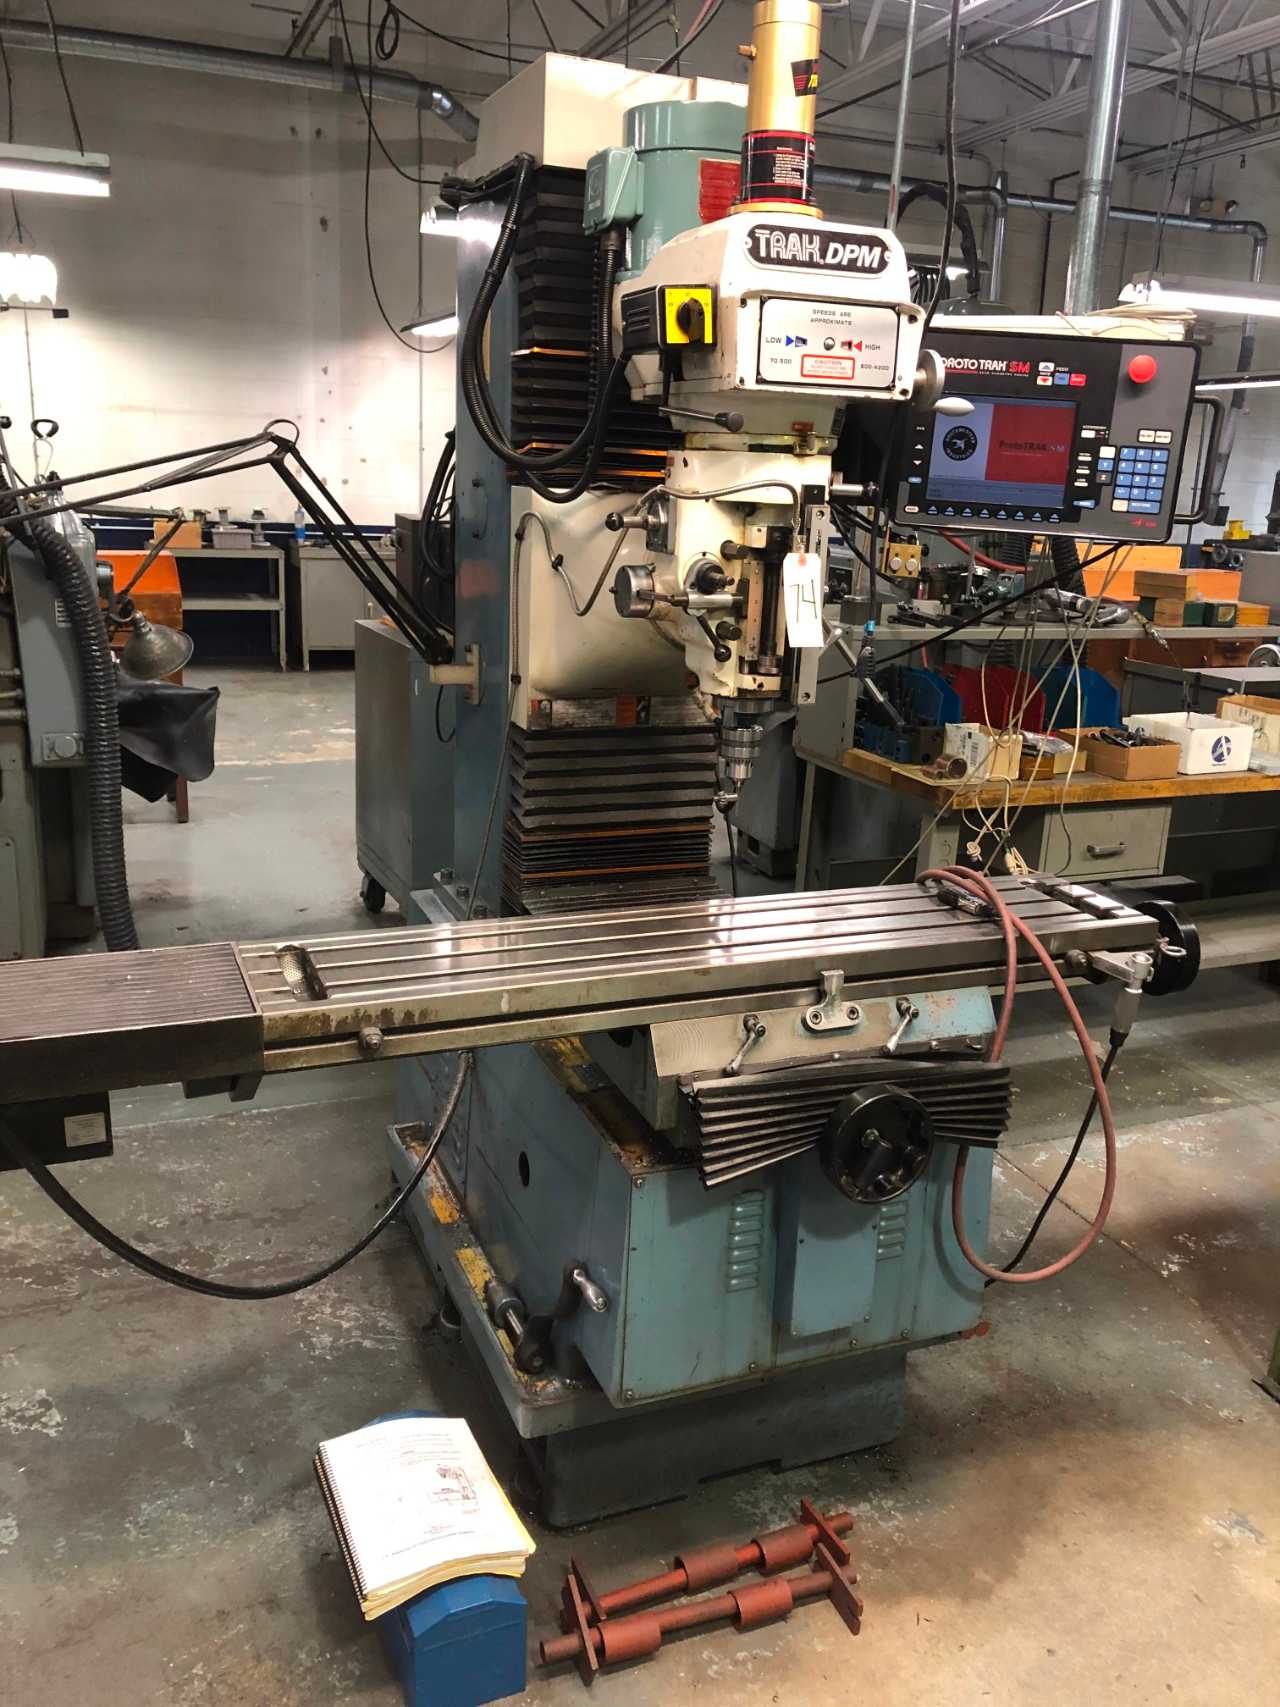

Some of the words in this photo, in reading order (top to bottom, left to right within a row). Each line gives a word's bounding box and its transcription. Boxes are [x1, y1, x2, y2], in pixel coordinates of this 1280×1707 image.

[825, 242, 882, 268] DPM
[765, 336, 782, 344] LOW
[1008, 361, 1031, 374] SM
